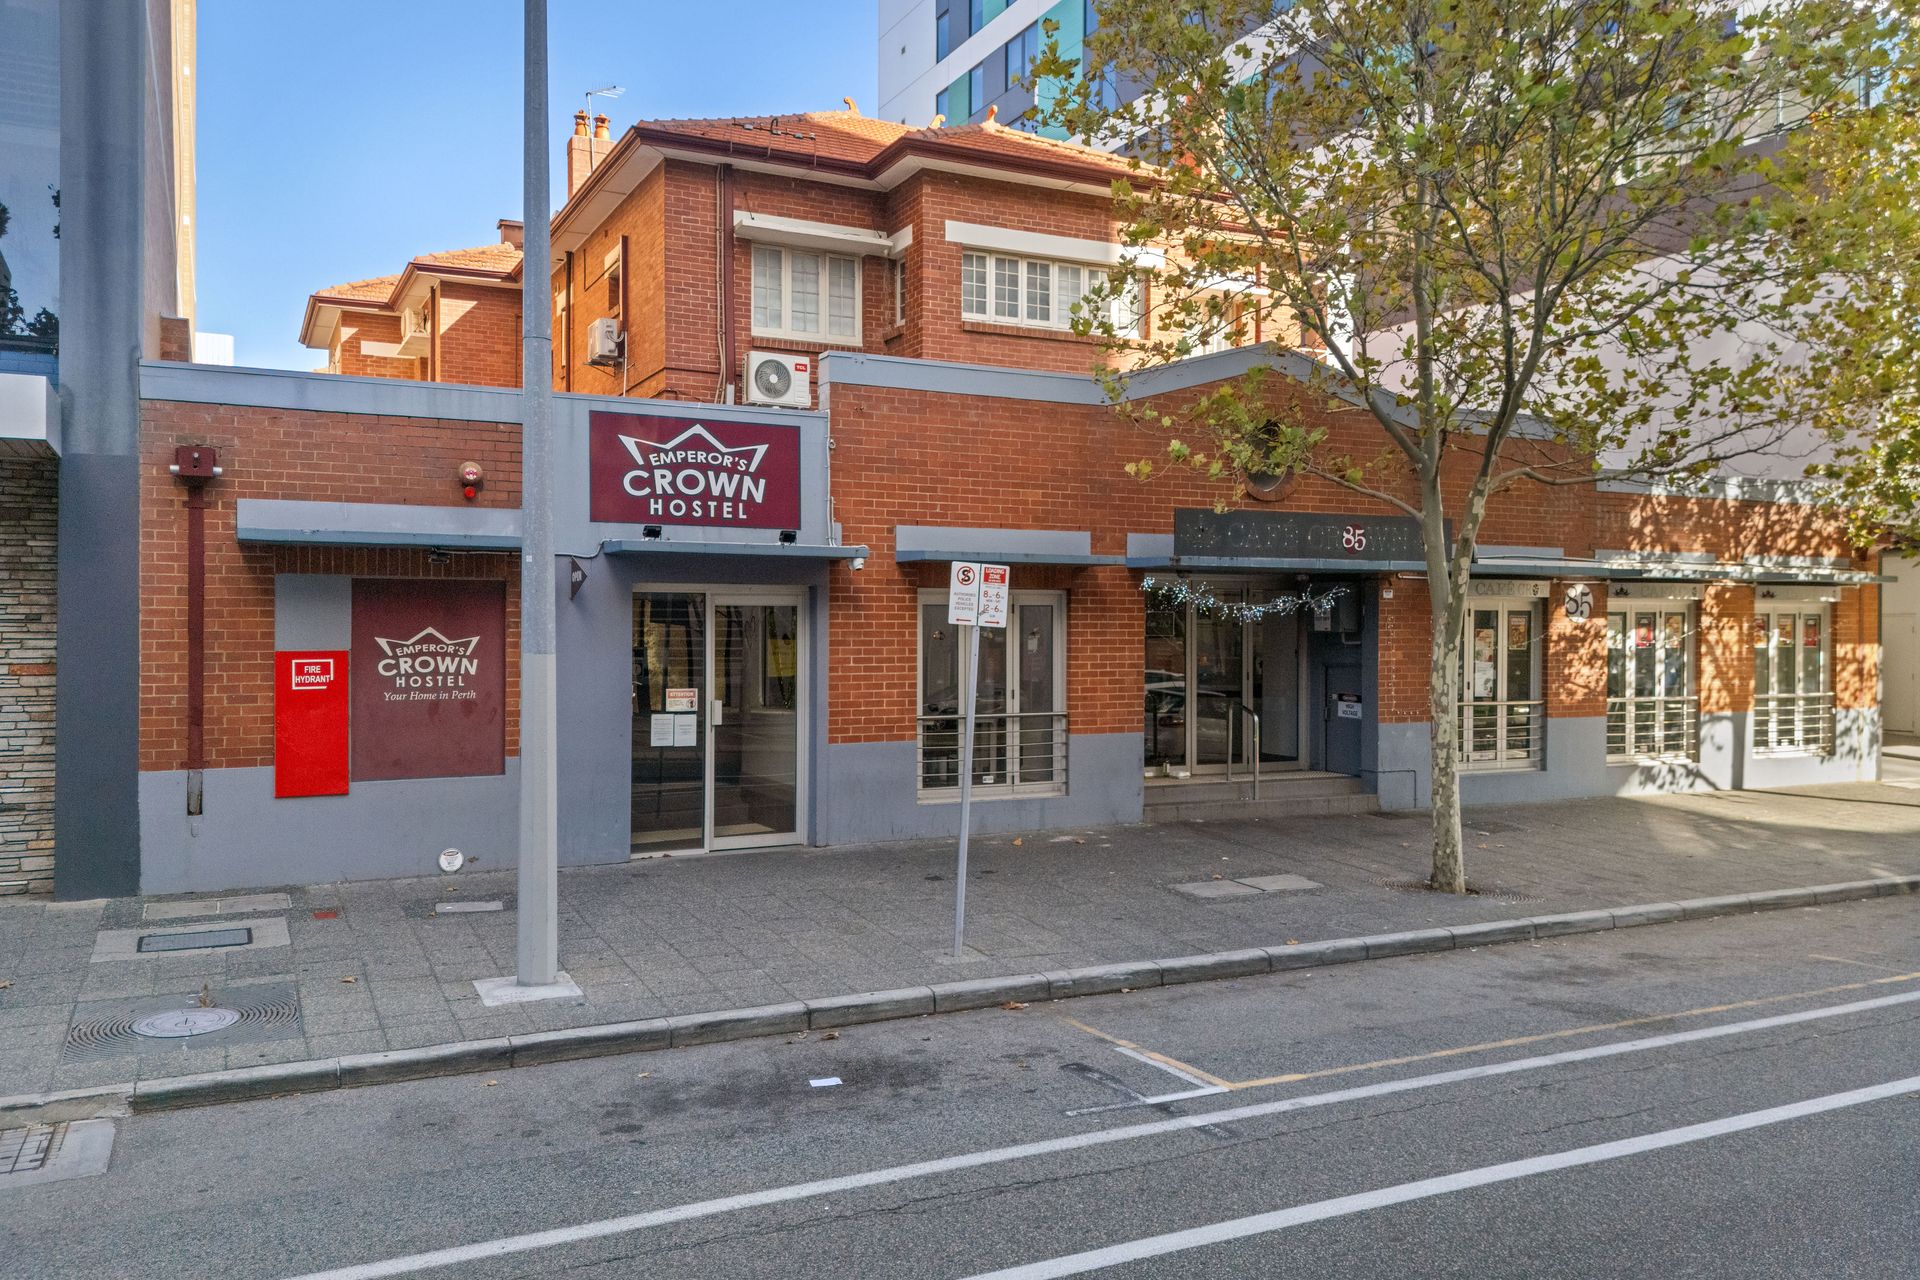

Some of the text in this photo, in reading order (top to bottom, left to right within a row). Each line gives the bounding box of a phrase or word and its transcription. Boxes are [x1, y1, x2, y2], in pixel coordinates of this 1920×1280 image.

[649, 450, 748, 471] EMPEROR'S
[623, 469, 766, 503] CROWN
[650, 499, 747, 519] HOSTEL
[1342, 526, 1366, 550] 85
[1565, 586, 1592, 617] 85
[395, 643, 465, 656] EMPEROR'S
[304, 665, 321, 674] FIRE
[377, 656, 479, 676] CROWN
[295, 675, 330, 684] HYDRANT
[396, 676, 465, 688] HOSTEL
[384, 690, 476, 701] Your Home in Perth
